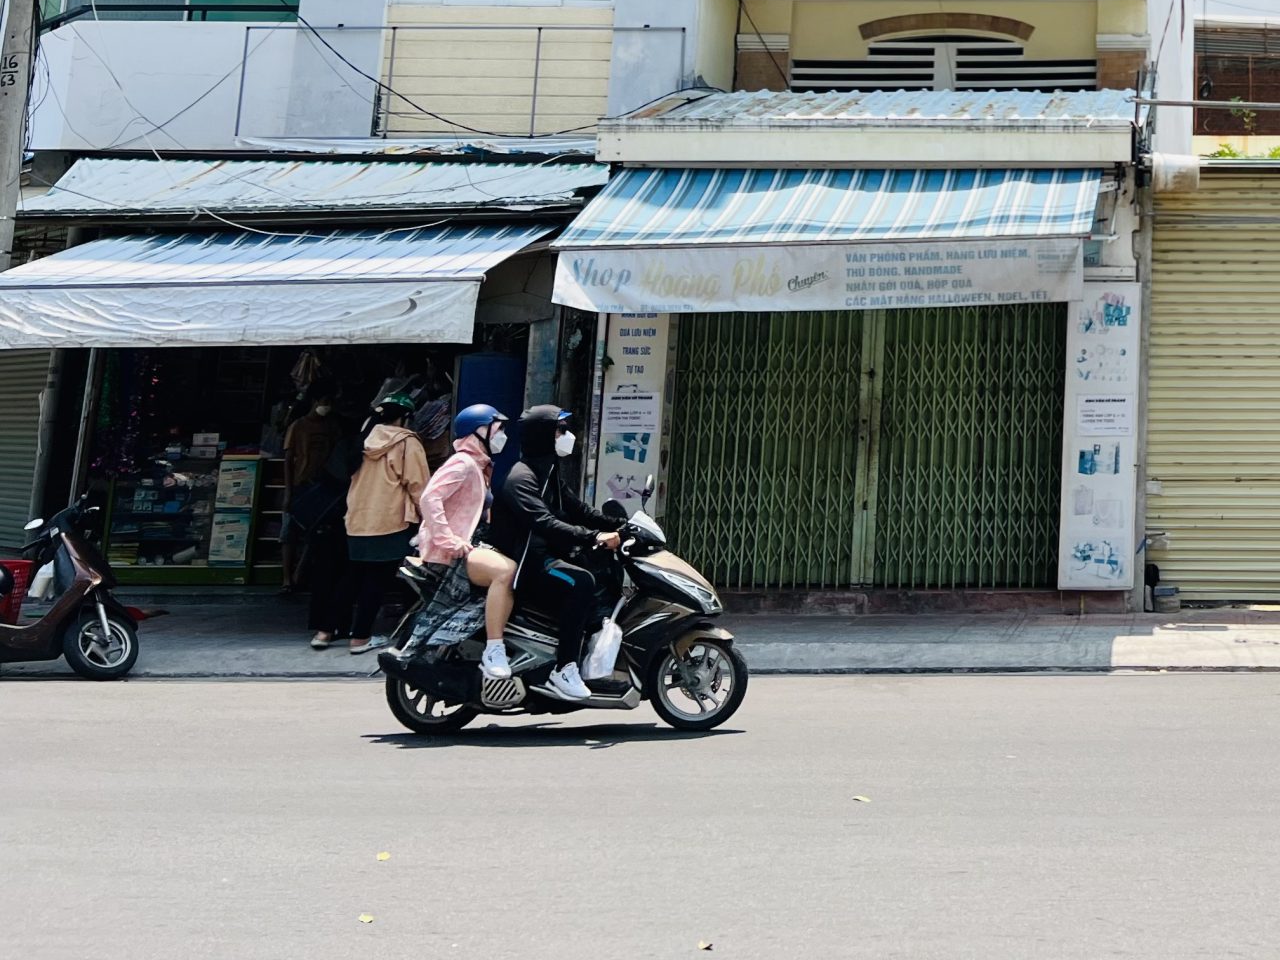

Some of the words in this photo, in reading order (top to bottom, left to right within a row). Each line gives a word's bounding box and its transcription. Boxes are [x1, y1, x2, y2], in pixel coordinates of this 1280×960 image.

[2, 55, 18, 69] 16
[572, 257, 632, 293] Shop
[904, 265, 962, 276] HANDMADE
[622, 346, 639, 355] TRANG
